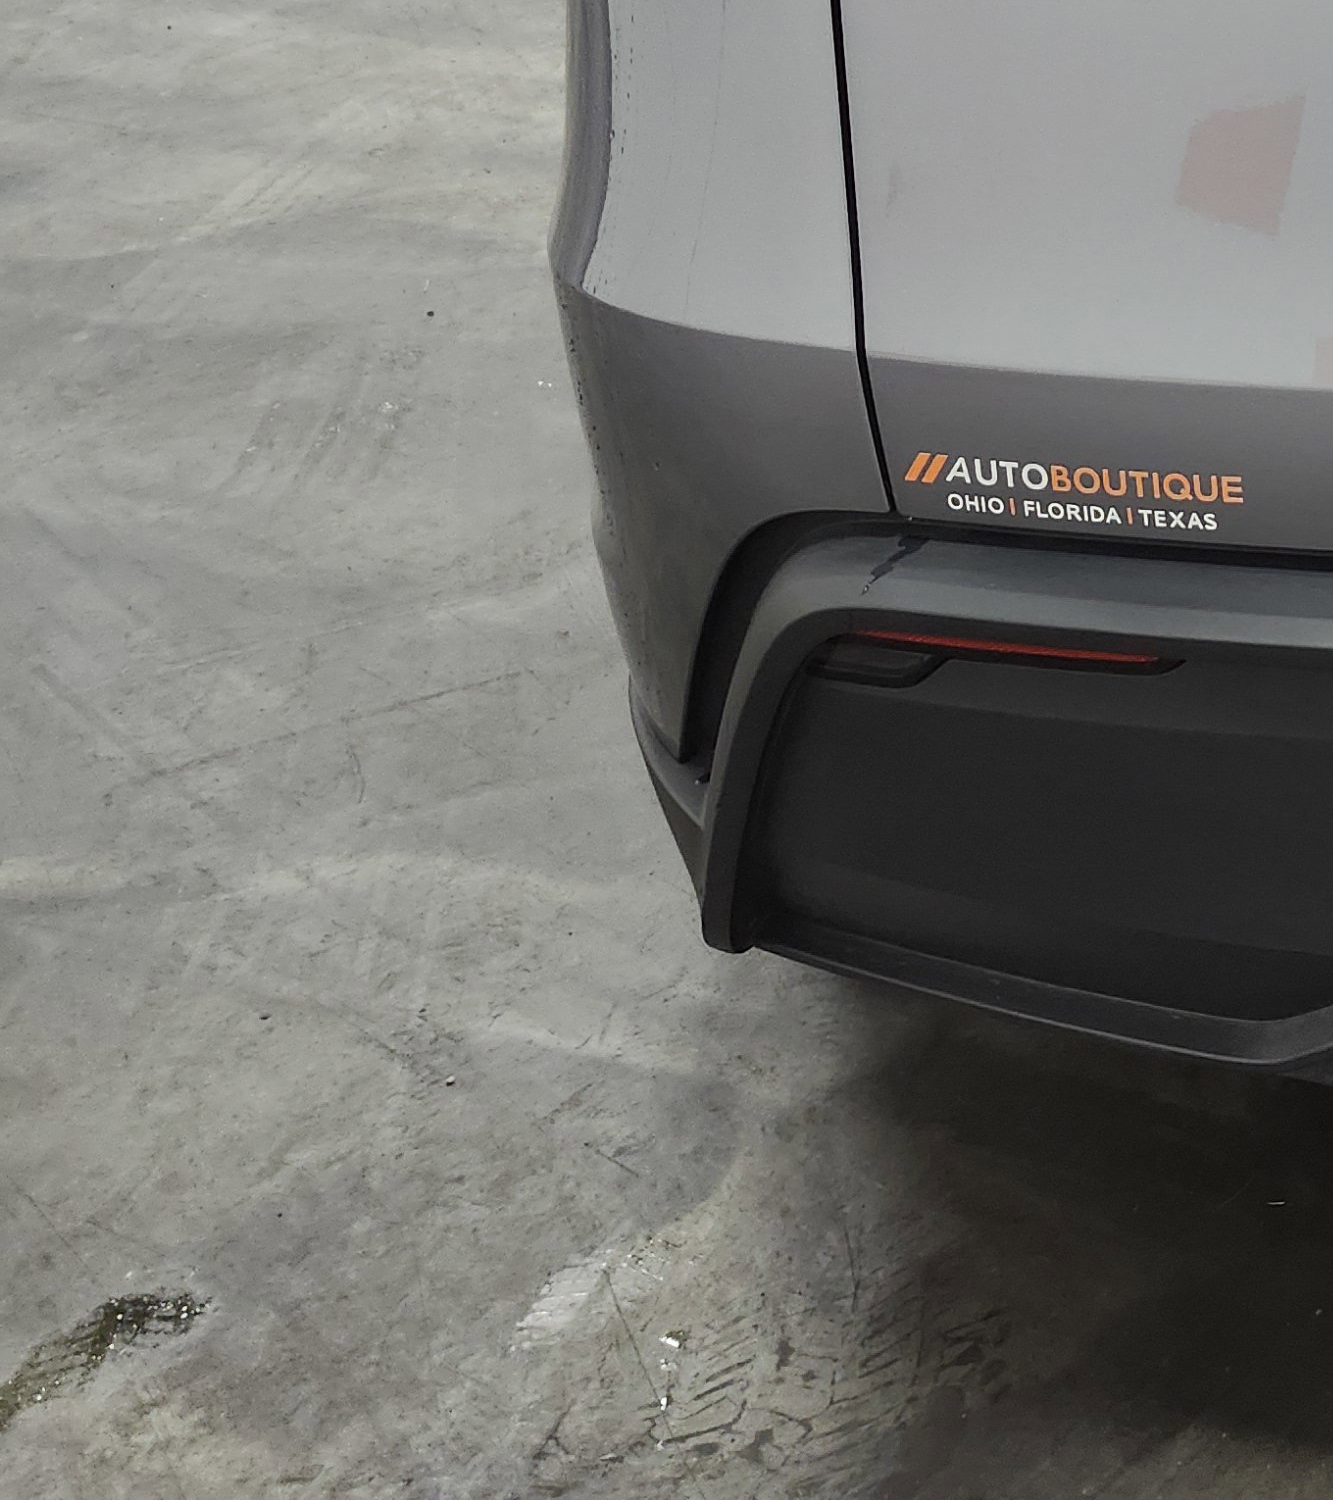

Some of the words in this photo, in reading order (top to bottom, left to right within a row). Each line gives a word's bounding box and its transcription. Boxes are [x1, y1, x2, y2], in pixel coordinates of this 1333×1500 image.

[945, 456, 1245, 504] AUTOBOUTIQUE
[947, 492, 1005, 515] OHIO
[1023, 500, 1122, 525] FLORIDA
[1138, 509, 1218, 531] TEXAS
